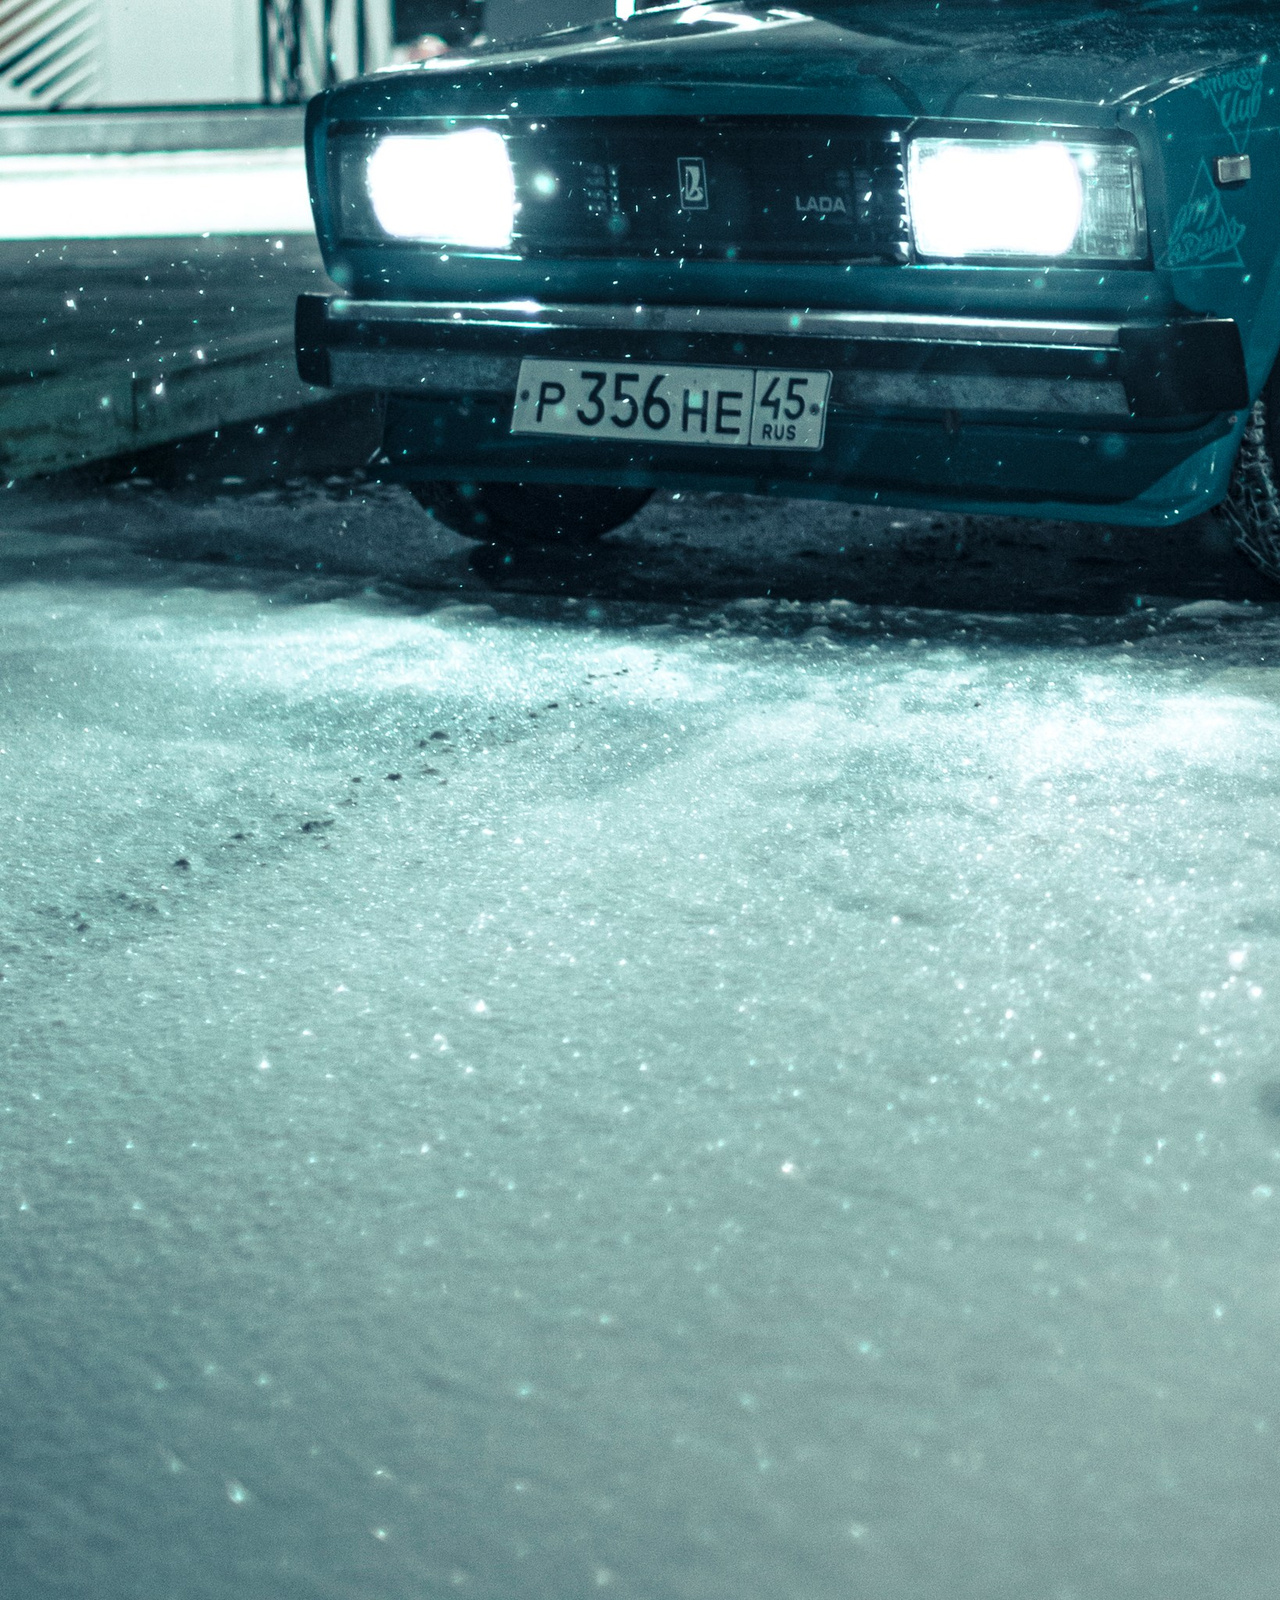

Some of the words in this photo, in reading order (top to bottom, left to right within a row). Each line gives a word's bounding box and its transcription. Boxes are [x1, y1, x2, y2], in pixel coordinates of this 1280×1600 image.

[795, 195, 847, 212] LADA
[760, 377, 808, 421] 45
[763, 424, 796, 440] RUS
